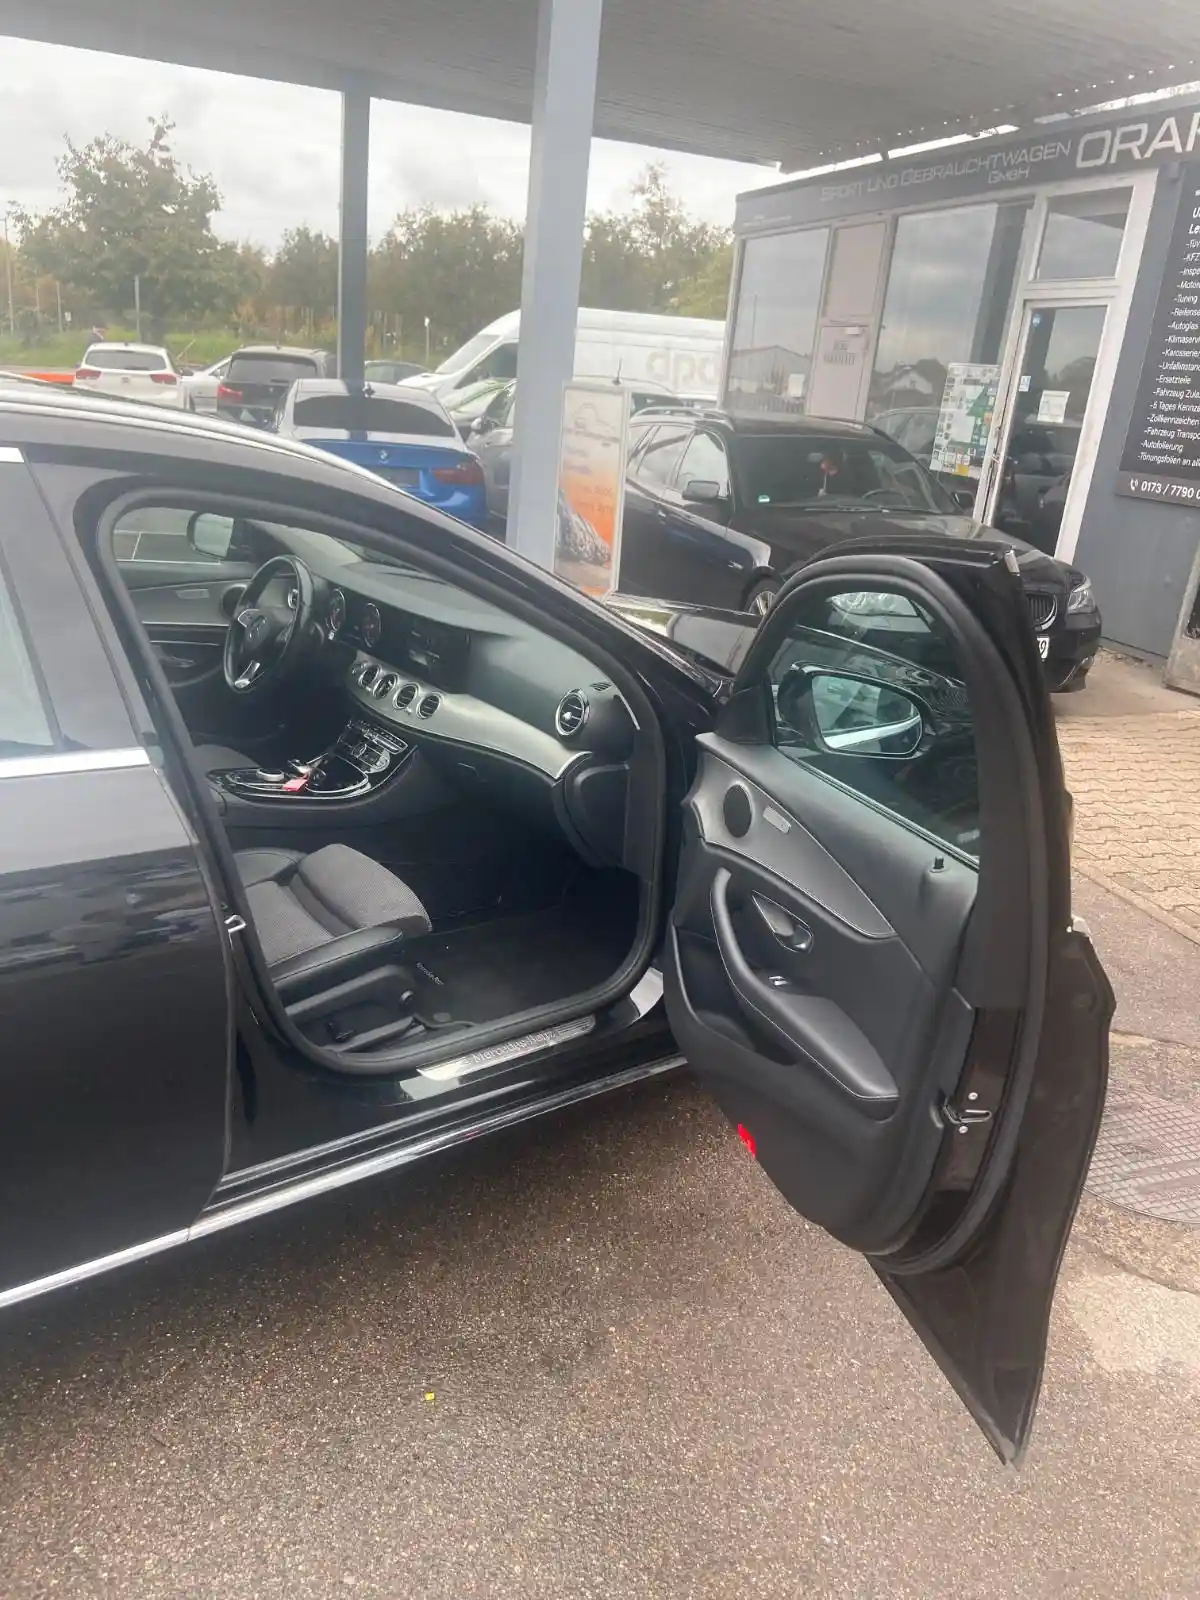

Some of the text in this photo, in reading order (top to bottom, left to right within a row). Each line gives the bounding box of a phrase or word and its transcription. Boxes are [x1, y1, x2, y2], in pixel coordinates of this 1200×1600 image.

[867, 172, 899, 193] UND
[901, 138, 1072, 187] GEBRAUCHTWAGEN
[1141, 480, 1162, 494] 0173
[1170, 485, 1194, 498] 7790
